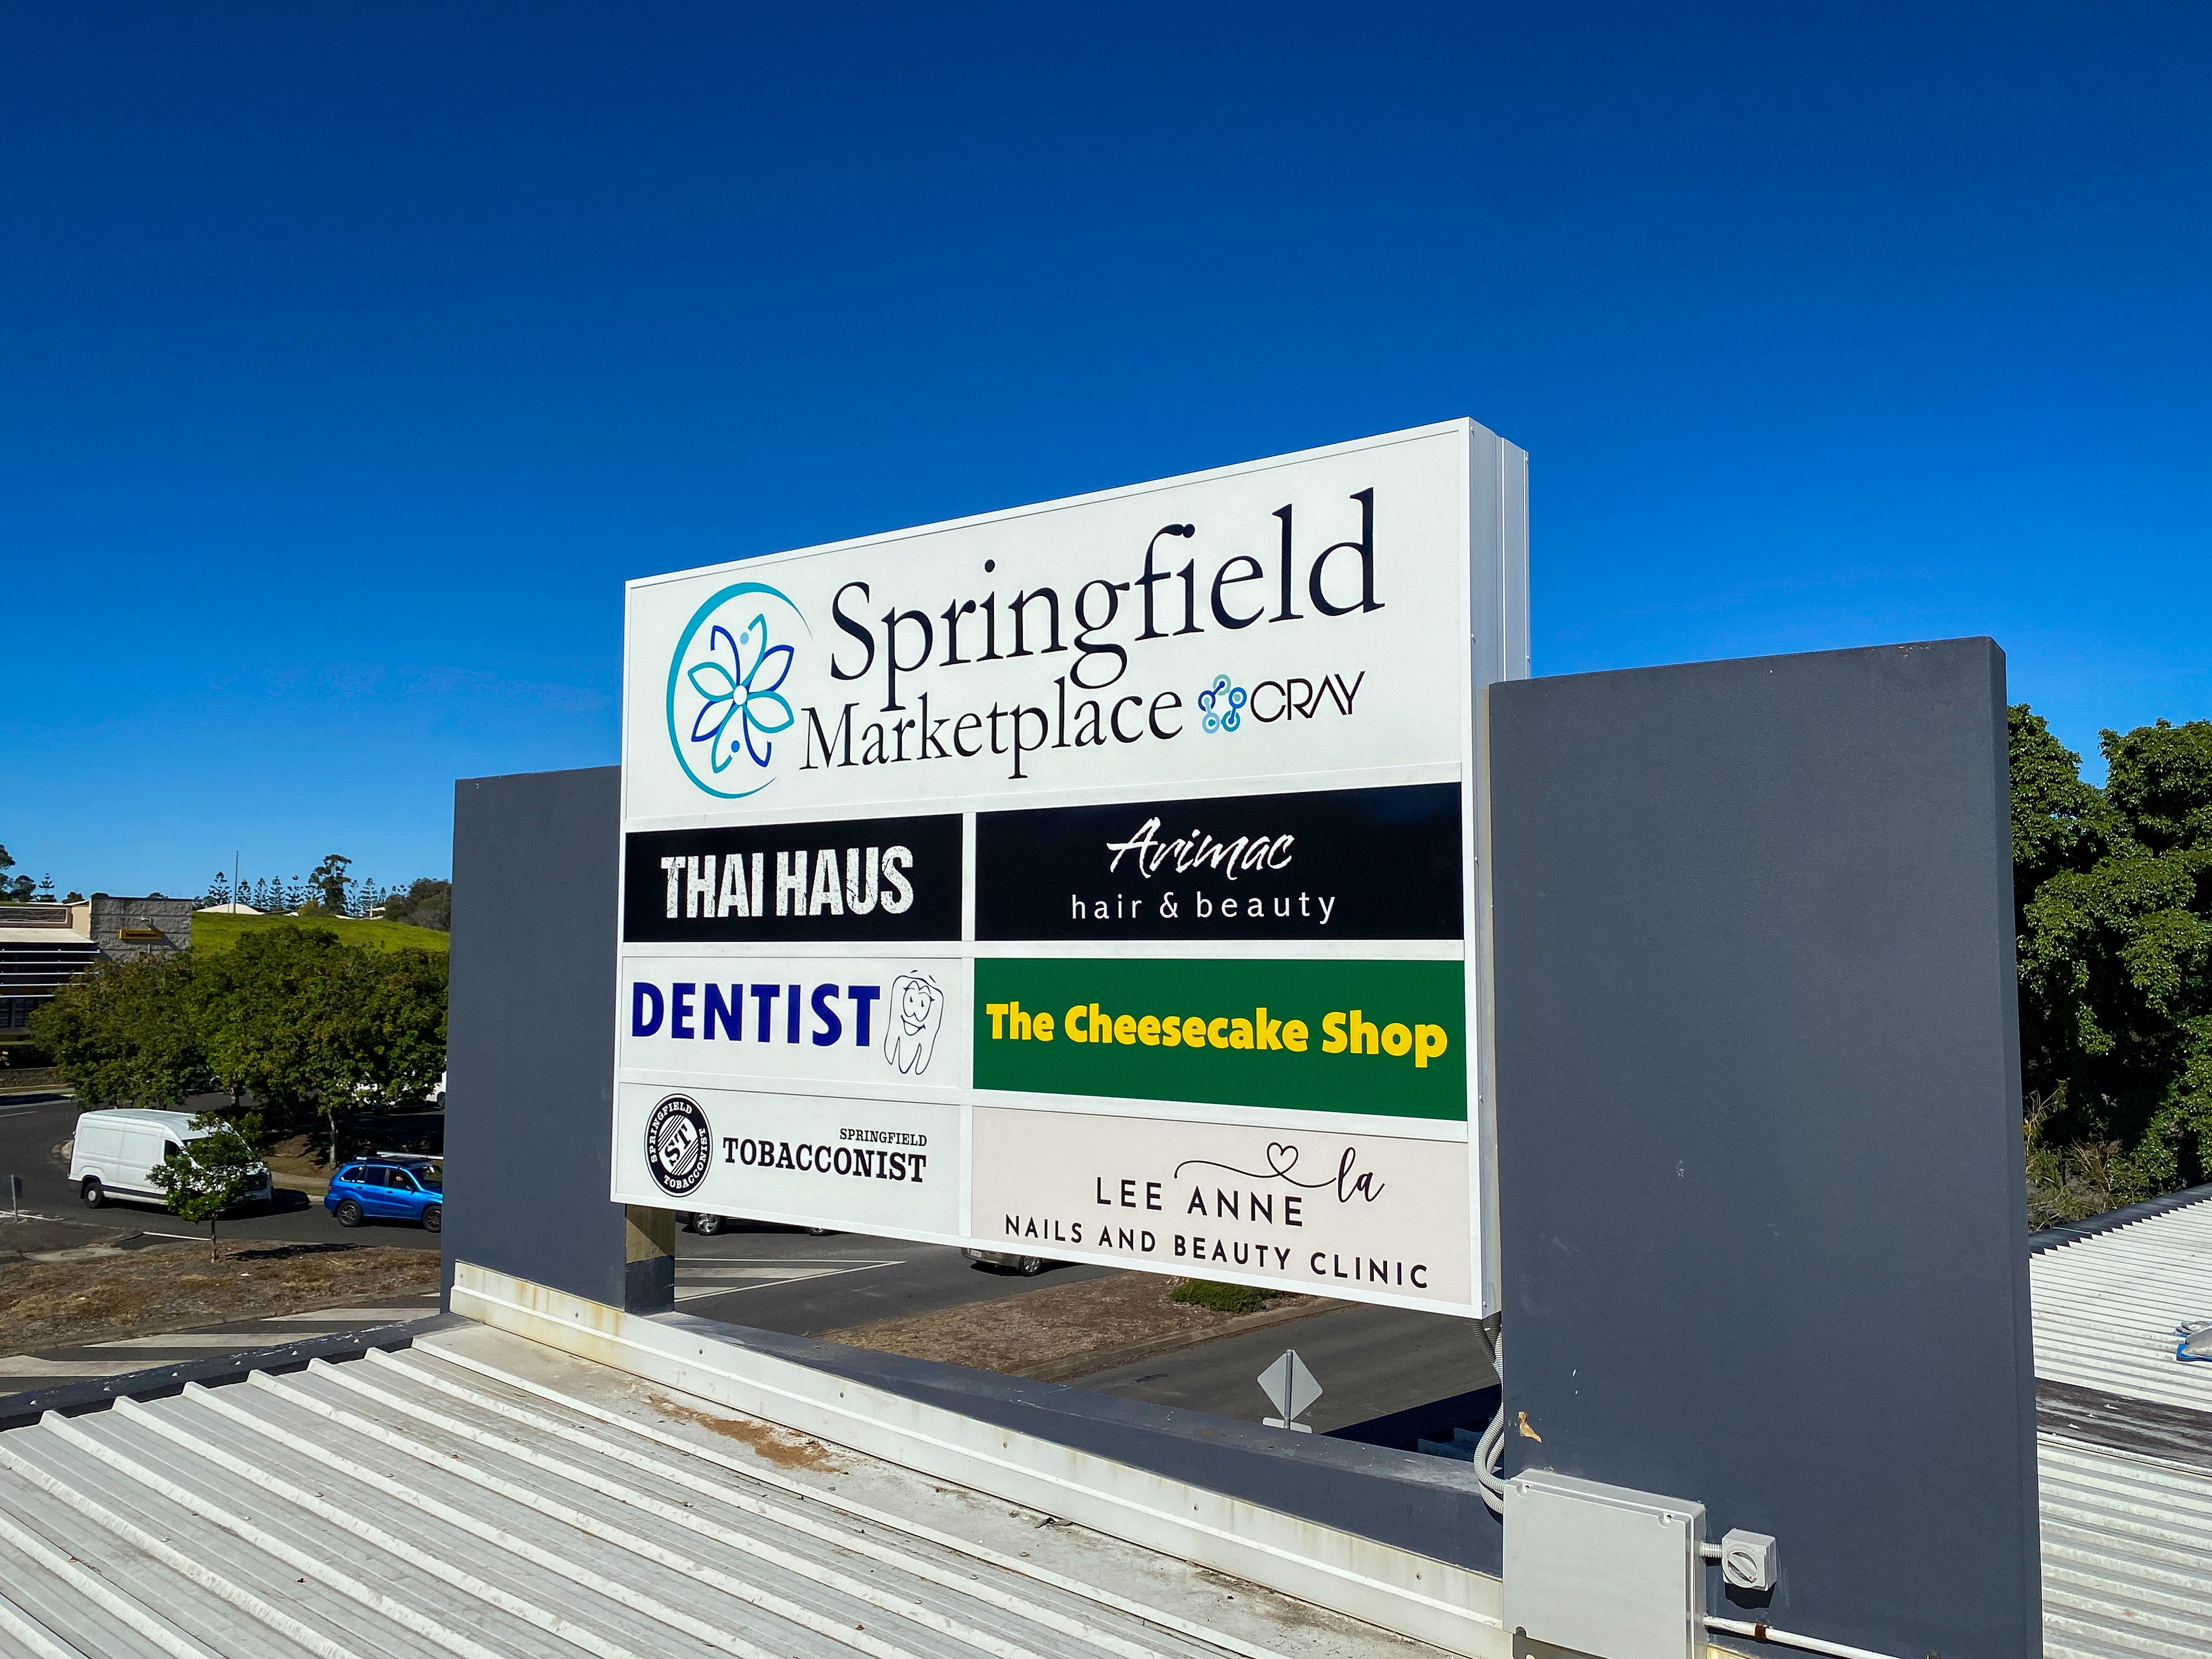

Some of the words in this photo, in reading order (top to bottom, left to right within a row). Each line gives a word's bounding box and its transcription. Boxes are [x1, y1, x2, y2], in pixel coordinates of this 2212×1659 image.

[831, 487, 1385, 712] Springfield
[799, 676, 1182, 779] Marketplace
[1251, 671, 1365, 722] CRAY
[1107, 817, 1294, 880] Arimac
[661, 853, 763, 918] THAI
[776, 846, 913, 916] HAUS
[1073, 894, 1142, 918] hair
[1160, 892, 1178, 918] &
[1197, 891, 1335, 924] beauty
[632, 982, 880, 1046] DENTIST
[986, 1001, 1054, 1041] The
[1065, 1003, 1308, 1052] Cheesecake
[1322, 1010, 1447, 1068] Shop
[649, 1101, 692, 1163] SPRINGFIELD
[664, 1123, 691, 1167] ST
[664, 1128, 708, 1189] TOBACCONIST
[723, 1137, 927, 1183] TOBACCONIST
[840, 1128, 927, 1146] SPRINGFIELD
[1097, 1177, 1161, 1210] LEE
[1188, 1186, 1302, 1226] ANNE
[1006, 1214, 1081, 1243] NAILS
[1098, 1226, 1155, 1251] AND
[1175, 1235, 1290, 1269] BEAUTY
[1311, 1252, 1427, 1288] CLINIC
